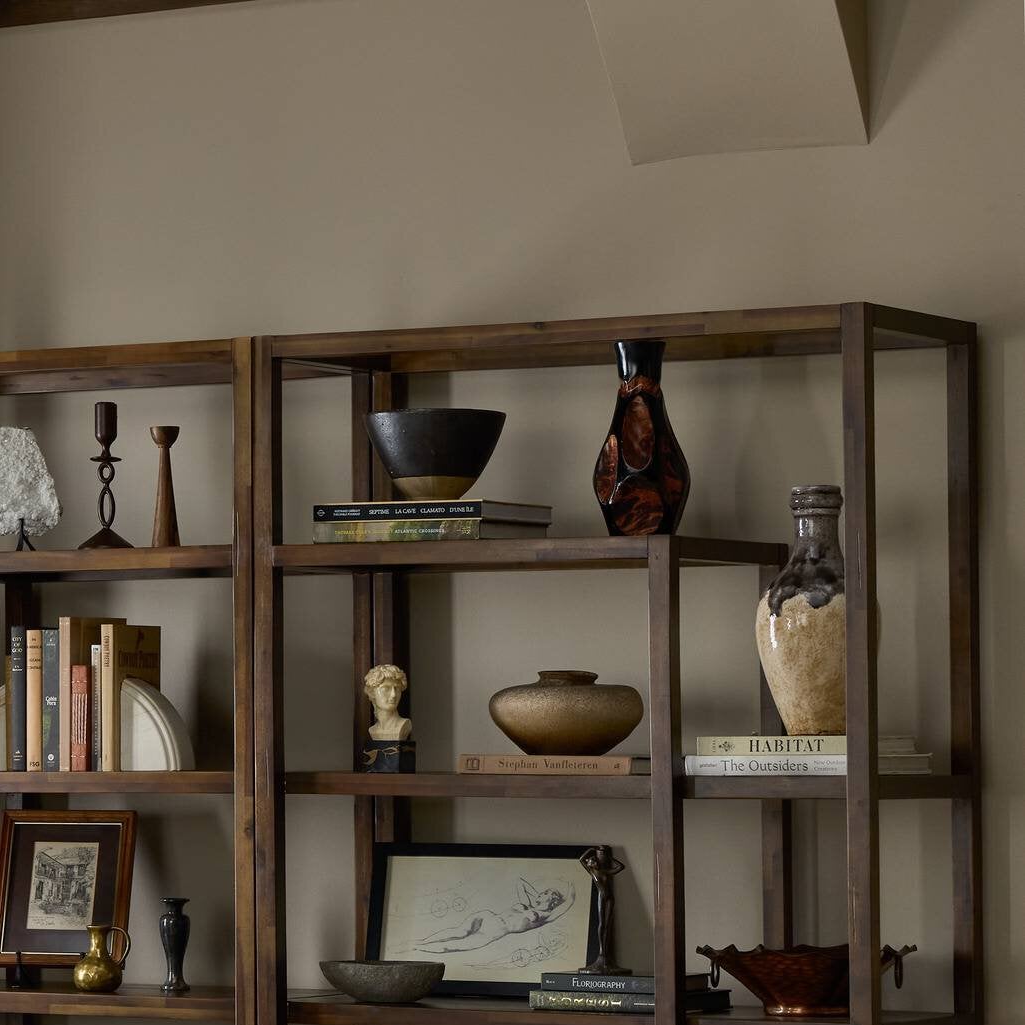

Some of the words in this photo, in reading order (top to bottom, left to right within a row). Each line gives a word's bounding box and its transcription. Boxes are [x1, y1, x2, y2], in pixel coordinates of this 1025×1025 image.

[749, 739, 824, 752] HABITAT
[497, 758, 538, 771] Stephan
[543, 758, 598, 769] Vanfleteren
[720, 759, 745, 772] The
[748, 759, 808, 772] Outsiders
